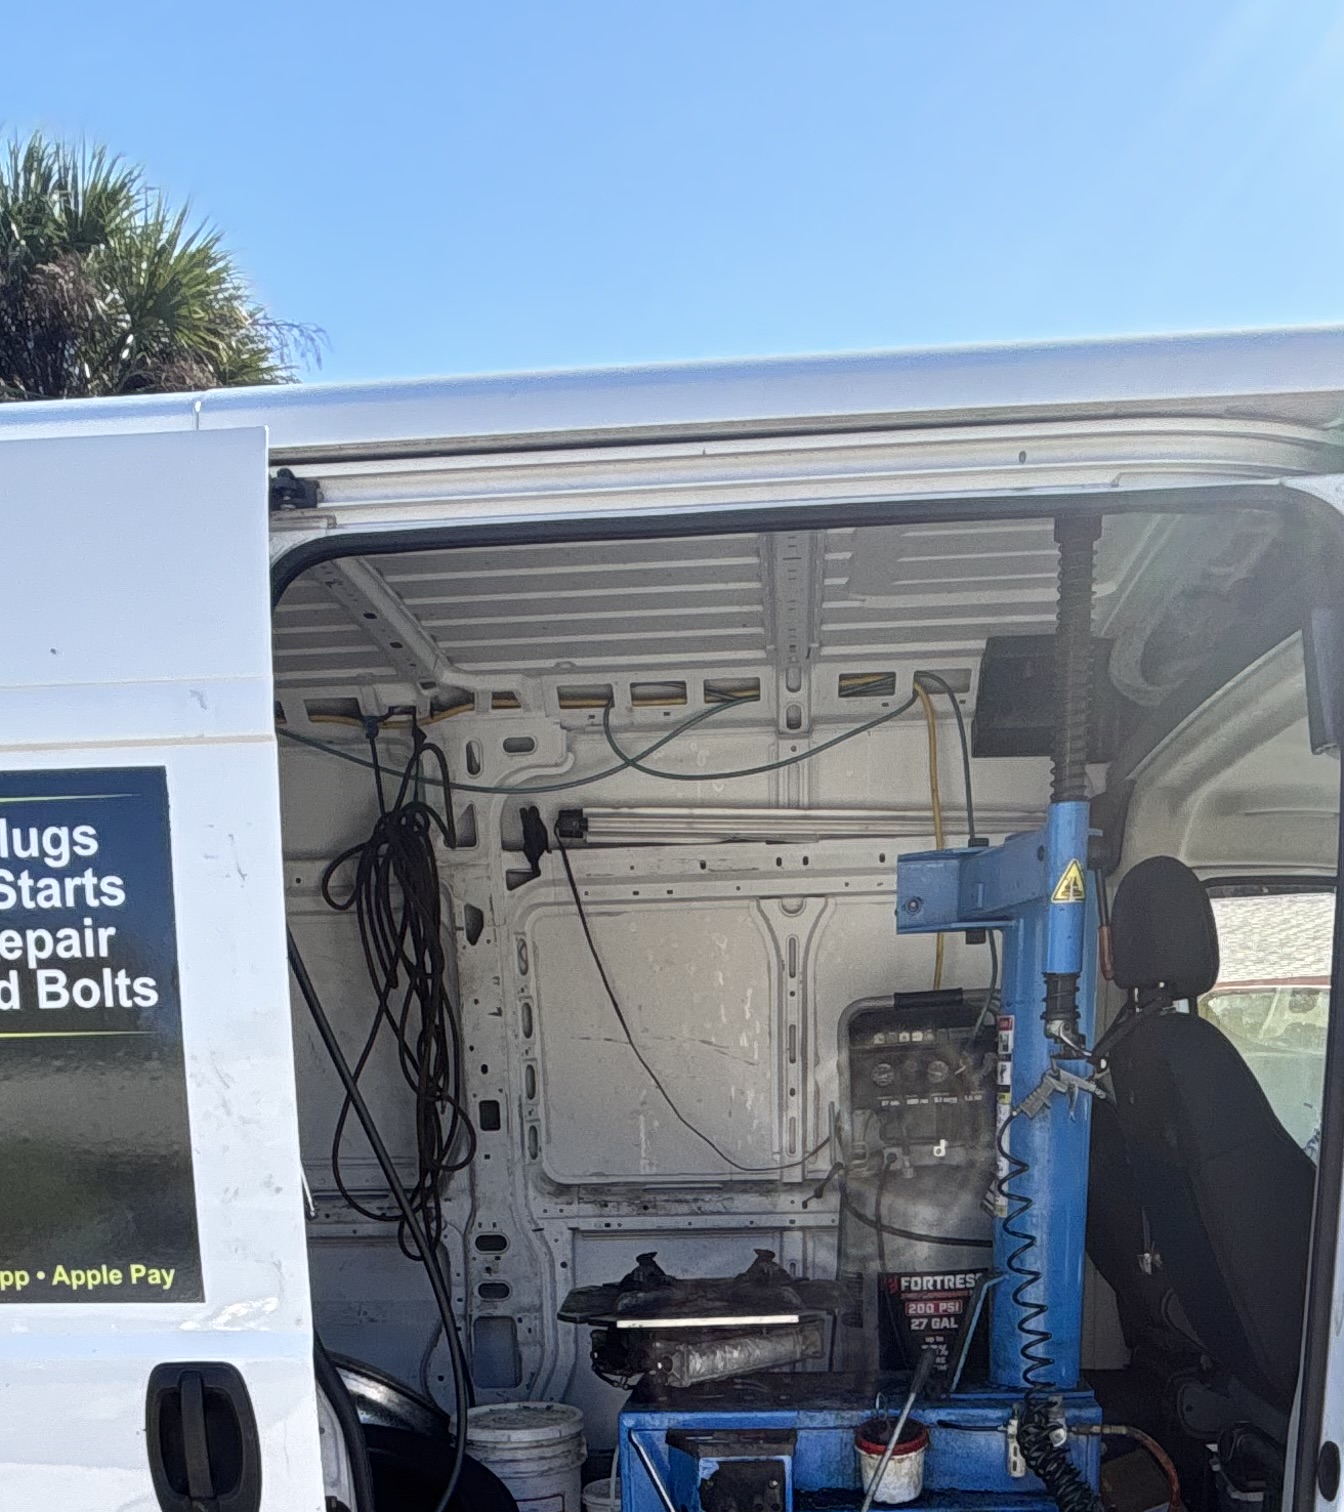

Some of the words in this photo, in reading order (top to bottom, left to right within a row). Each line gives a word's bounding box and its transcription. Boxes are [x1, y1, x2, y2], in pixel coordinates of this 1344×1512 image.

[35, 968, 159, 1010] Bolts
[52, 1262, 123, 1290] Apple
[130, 1263, 175, 1290] Pay
[901, 1273, 980, 1291] FORTRES
[908, 1303, 935, 1314] 200
[939, 1302, 960, 1313] PSI
[910, 1318, 928, 1330] 27
[931, 1317, 958, 1330] GAL
